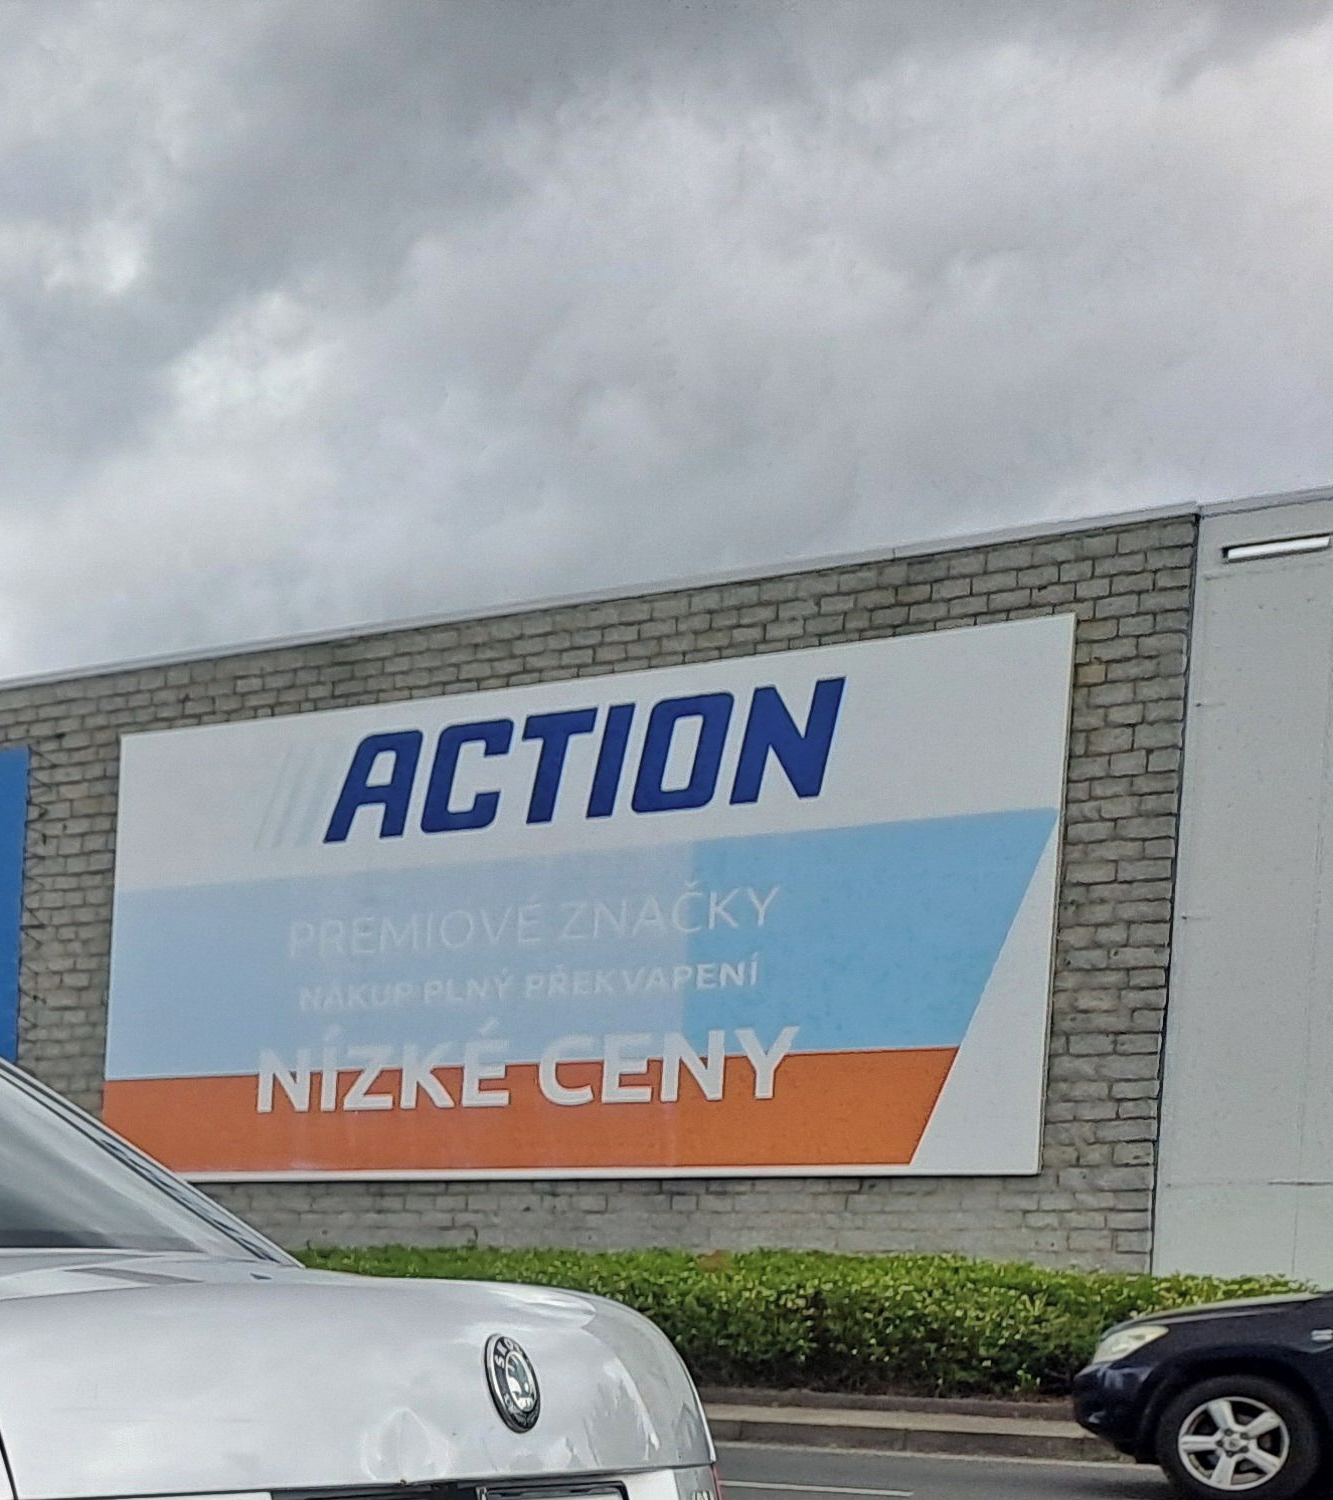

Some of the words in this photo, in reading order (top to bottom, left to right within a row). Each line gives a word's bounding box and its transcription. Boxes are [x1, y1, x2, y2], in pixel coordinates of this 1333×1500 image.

[323, 676, 846, 843] ACTION
[557, 880, 782, 940] ZNAČKY
[423, 967, 514, 1005] PLNÝ
[525, 951, 760, 997] PŘEKVAPENÍ
[256, 1016, 511, 1113] NÍZKÉ
[538, 1025, 801, 1107] CENY
